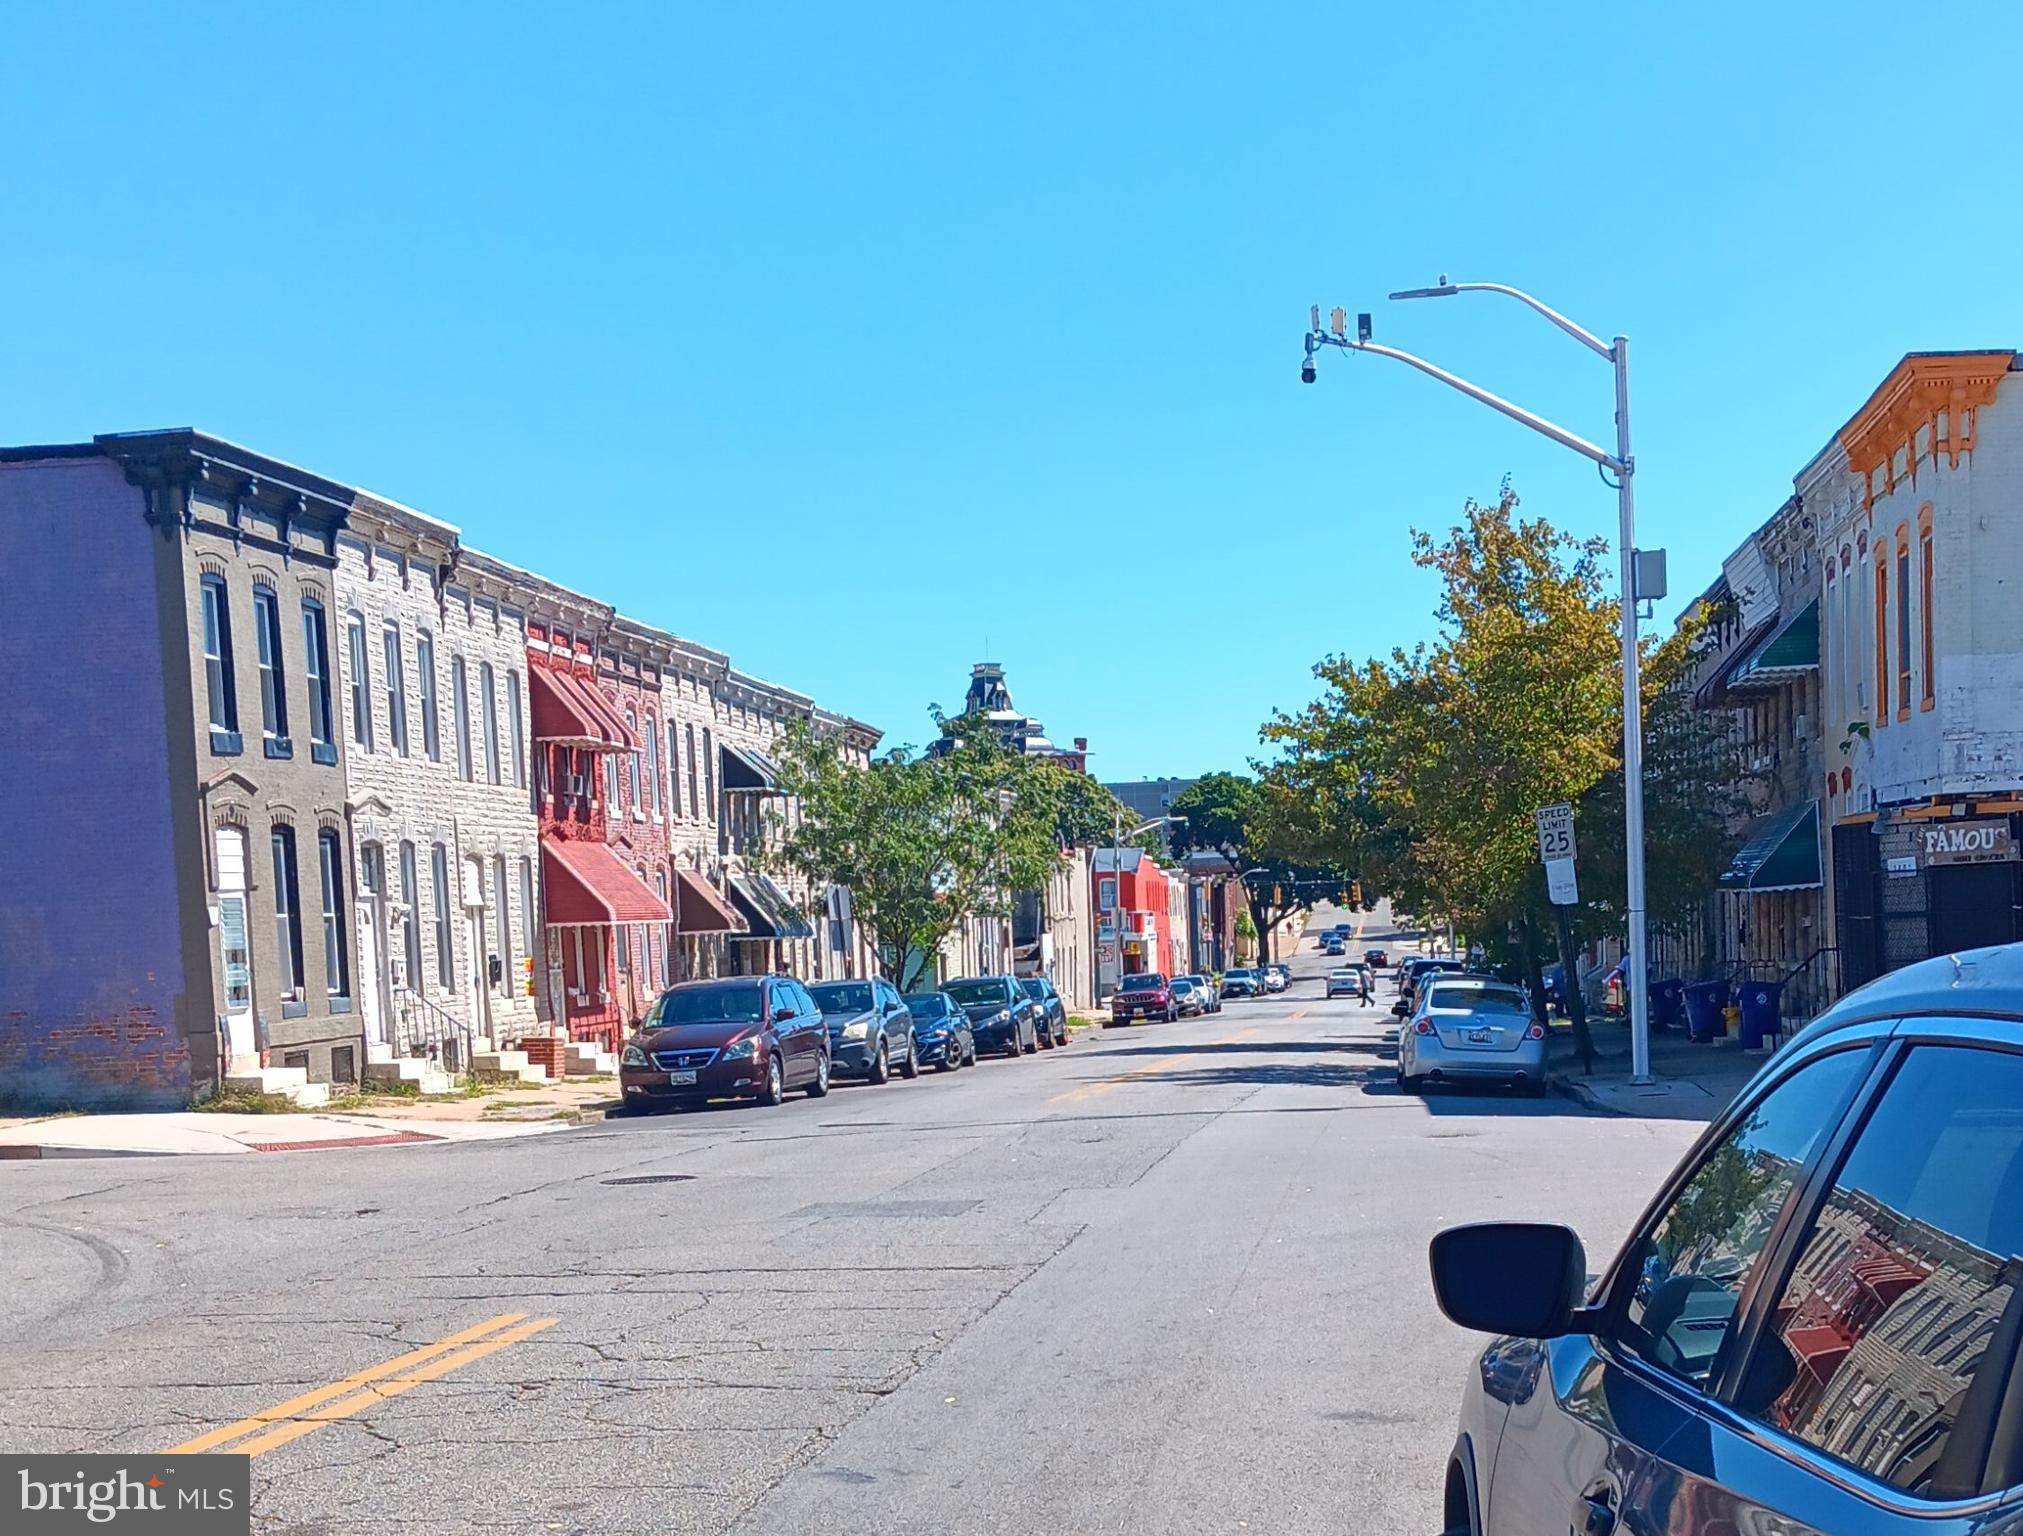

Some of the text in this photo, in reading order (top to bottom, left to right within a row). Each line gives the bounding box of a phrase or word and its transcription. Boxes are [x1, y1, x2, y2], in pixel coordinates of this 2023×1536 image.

[1538, 807, 1569, 820] SPEED
[1542, 819, 1566, 831] LIMIT
[1543, 831, 1570, 853] 25
